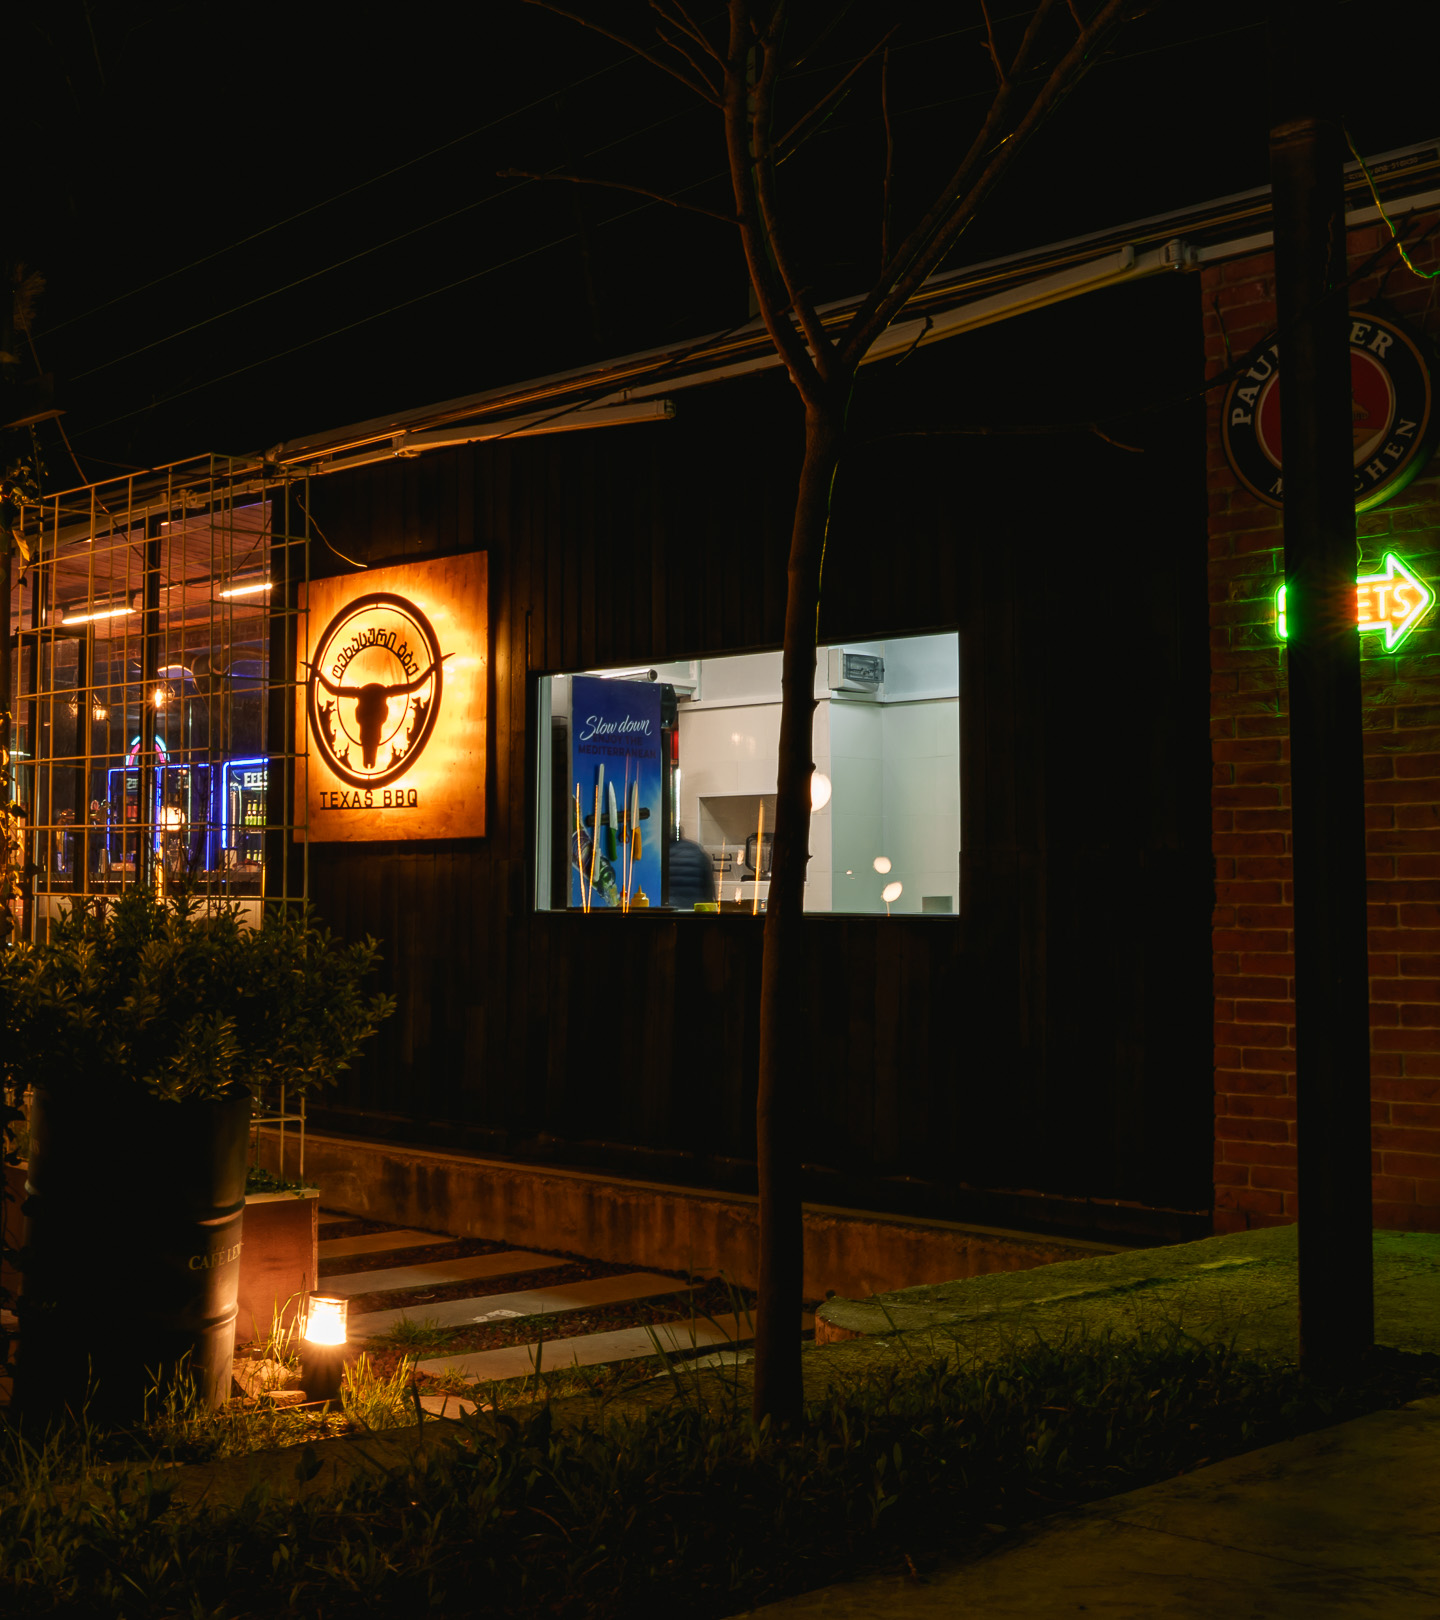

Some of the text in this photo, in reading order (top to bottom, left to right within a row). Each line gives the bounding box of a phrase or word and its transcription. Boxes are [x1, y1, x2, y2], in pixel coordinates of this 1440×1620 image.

[1231, 321, 1394, 427] PAUER
[579, 714, 652, 741] Slow down
[592, 733, 644, 746] ENJOY THE
[578, 743, 657, 759] MEDITERRANEAN
[320, 788, 418, 809] TEXAS BBQ
[188, 1246, 225, 1270] CAFÉ
